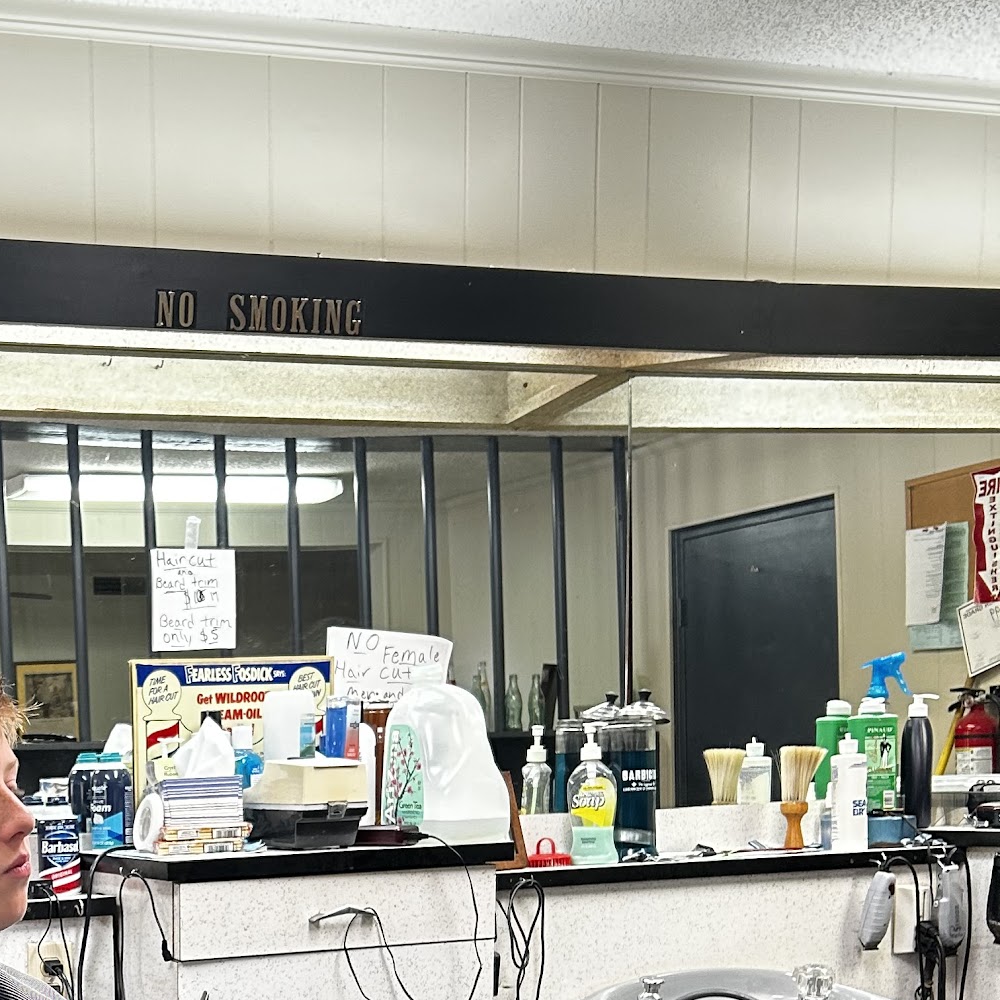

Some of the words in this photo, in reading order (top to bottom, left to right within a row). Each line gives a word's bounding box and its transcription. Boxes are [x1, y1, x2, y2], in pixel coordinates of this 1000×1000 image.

[156, 291, 195, 328] NO
[230, 294, 362, 336] SMOKING
[156, 577, 186, 590] Beard
[191, 577, 218, 588] trim
[160, 613, 195, 629] Beard
[200, 616, 232, 628] trim
[163, 631, 192, 647] only
[346, 631, 380, 651] NO
[383, 645, 440, 665] Female
[184, 664, 232, 684] FEARLESS
[231, 664, 274, 684] FOSDICK
[298, 672, 315, 682] BEST
[334, 660, 371, 679] Hair
[149, 676, 166, 686] TIME
[148, 686, 162, 696] FOR
[163, 684, 168, 693] A
[197, 693, 213, 704] Get
[215, 691, 268, 704] WILDROO
[220, 708, 262, 720] EAM-OIL
[399, 801, 413, 809] Green
[413, 800, 422, 809] Tea
[571, 794, 606, 811] Soap
[42, 840, 79, 854] Barbasol
